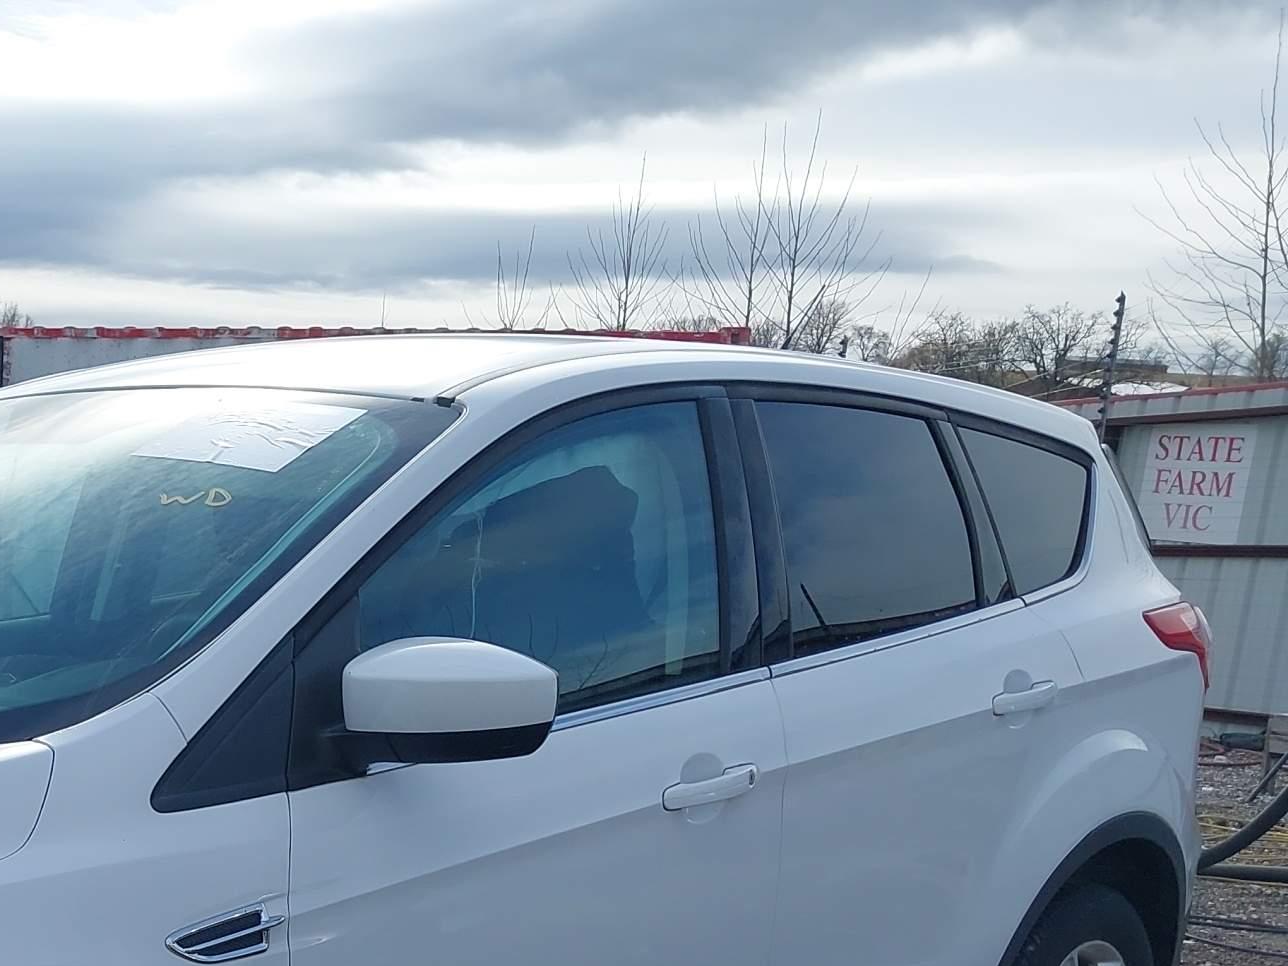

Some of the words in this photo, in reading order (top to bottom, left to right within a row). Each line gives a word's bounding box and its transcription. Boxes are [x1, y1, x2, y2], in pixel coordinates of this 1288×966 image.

[1155, 435, 1244, 462] STATE
[1153, 469, 1235, 497] FARM
[1164, 503, 1212, 530] VIC
